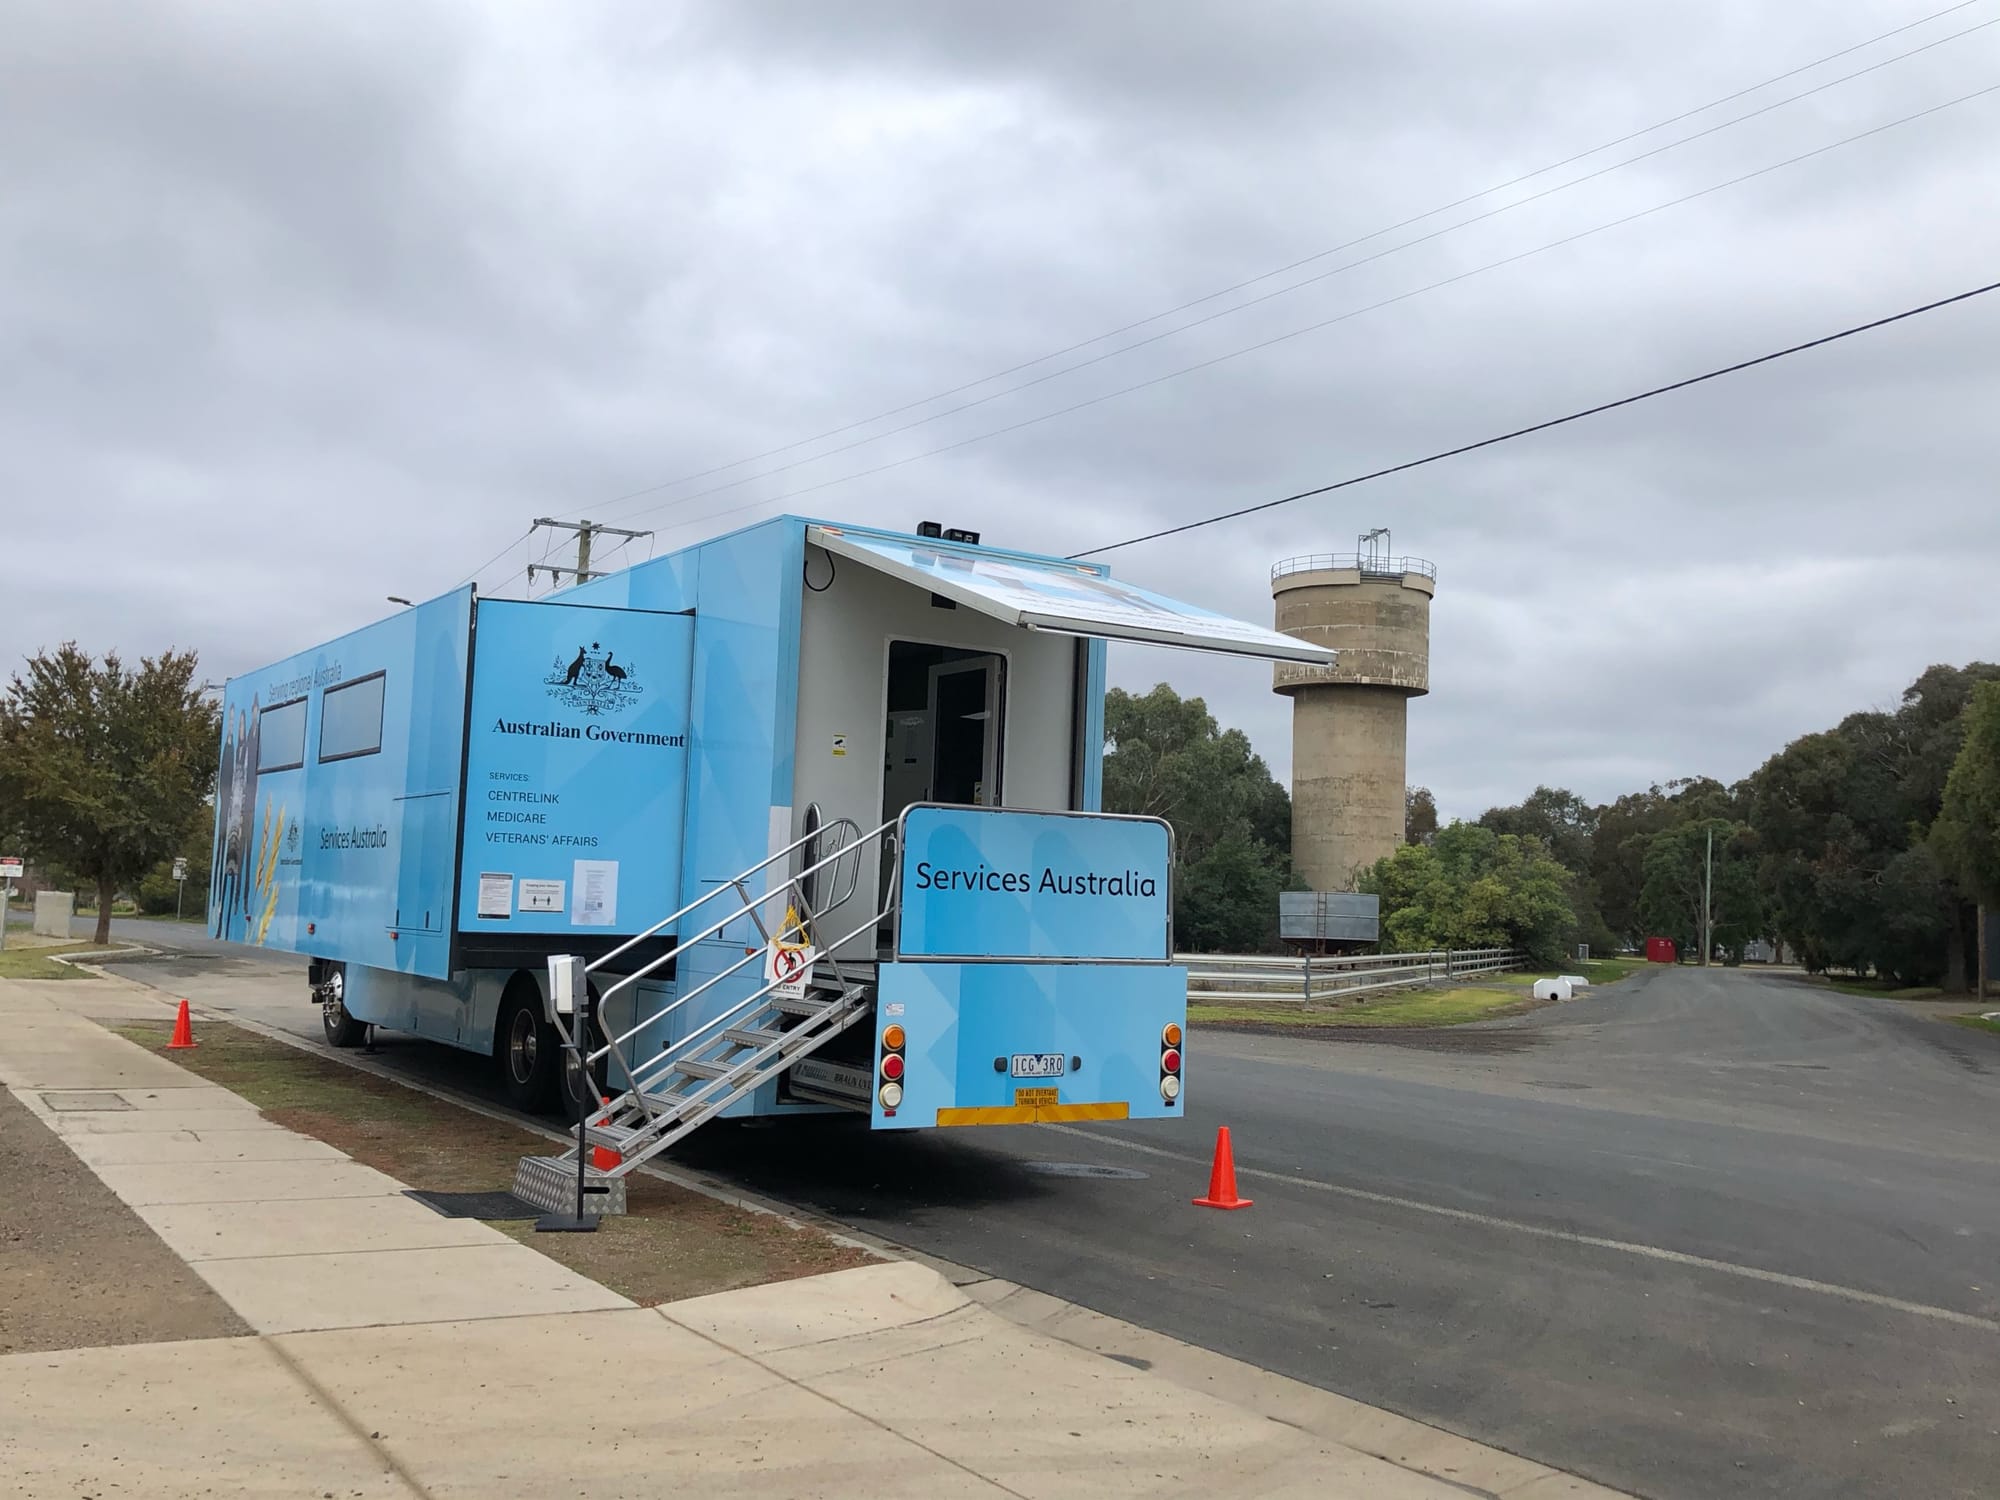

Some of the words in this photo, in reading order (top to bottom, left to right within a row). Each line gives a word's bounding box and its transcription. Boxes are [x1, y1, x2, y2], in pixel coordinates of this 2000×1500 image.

[314, 660, 342, 688] Australia
[492, 717, 581, 739] Australian
[585, 724, 685, 747] Government
[488, 790, 560, 804] CENTRELINK
[487, 811, 547, 824] MEDICARE
[320, 826, 350, 850] Services
[350, 824, 387, 849] Australia
[485, 831, 549, 845] VETERANS'
[551, 835, 599, 847] AFFAIRS
[916, 862, 1030, 893] Services
[1038, 867, 1156, 897] Australia
[1015, 1057, 1035, 1072] 1CG
[1025, 1088, 1034, 1097] NOT
[1038, 1096, 1056, 1105] VEHICLE
